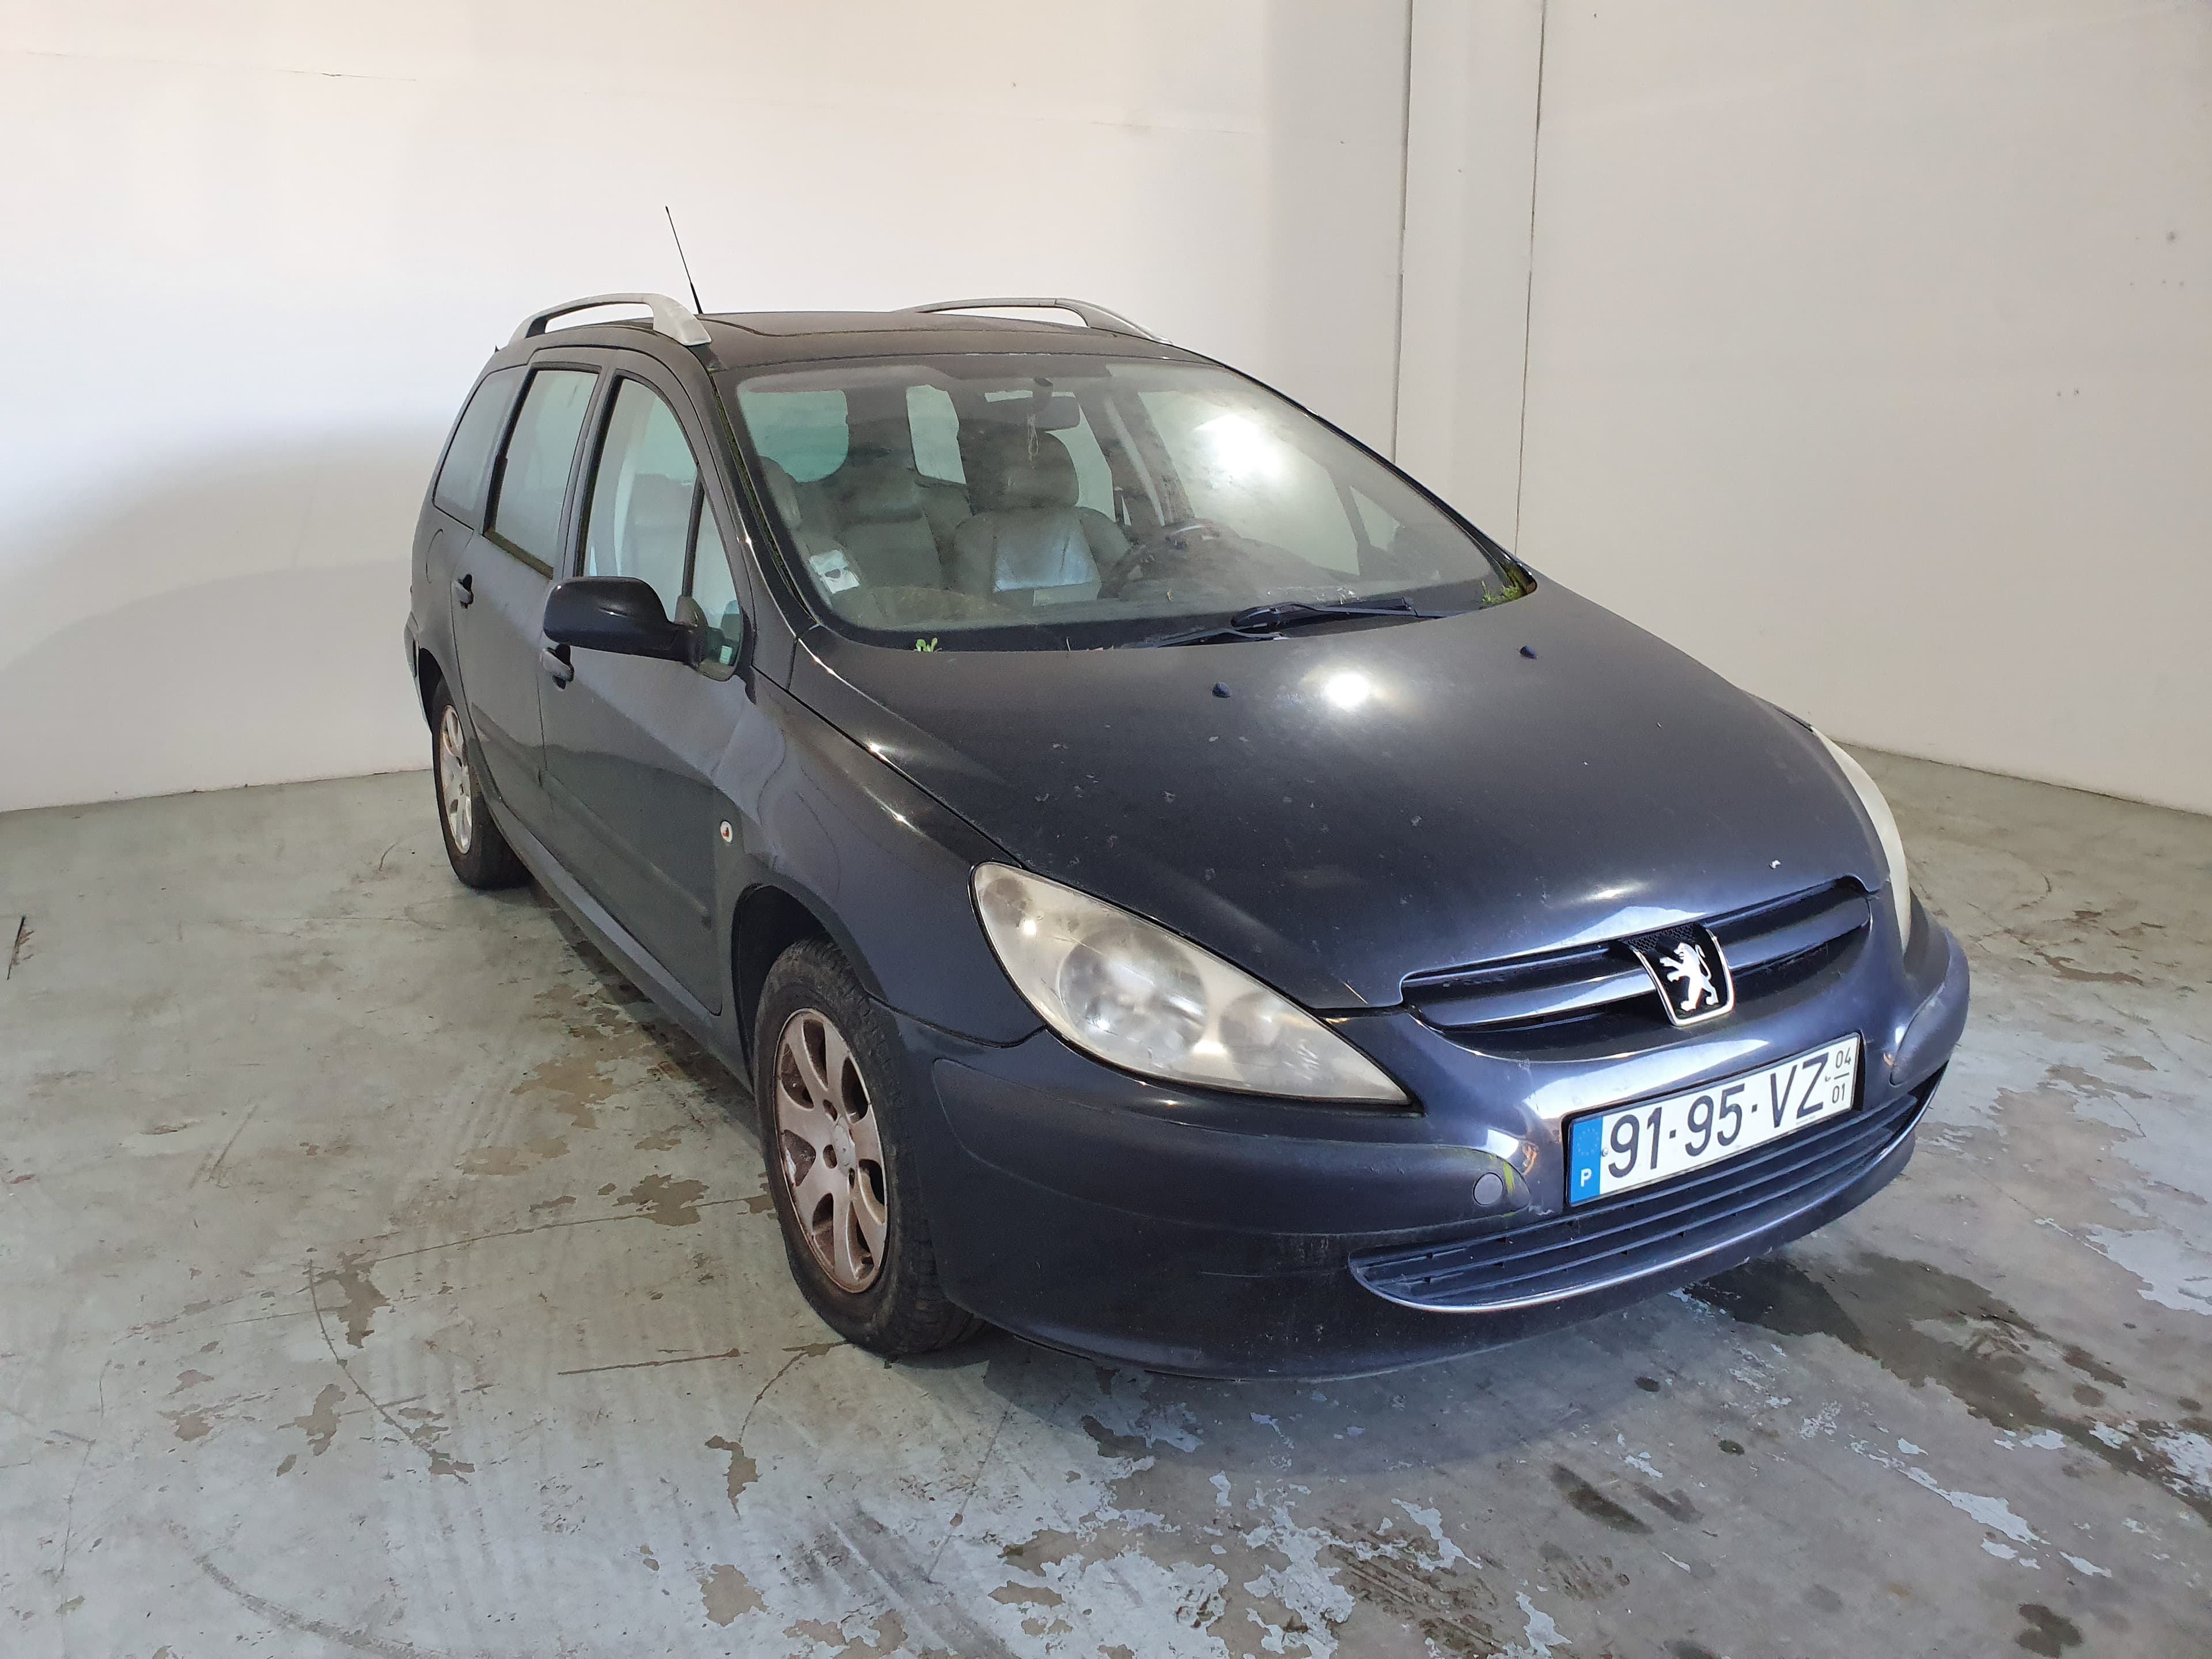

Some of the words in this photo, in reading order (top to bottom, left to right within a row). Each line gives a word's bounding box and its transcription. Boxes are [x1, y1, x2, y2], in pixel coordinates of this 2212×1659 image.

[1835, 1047, 1851, 1069] 04
[1832, 1083, 1845, 1104] 01
[1580, 1168, 1592, 1187] P
